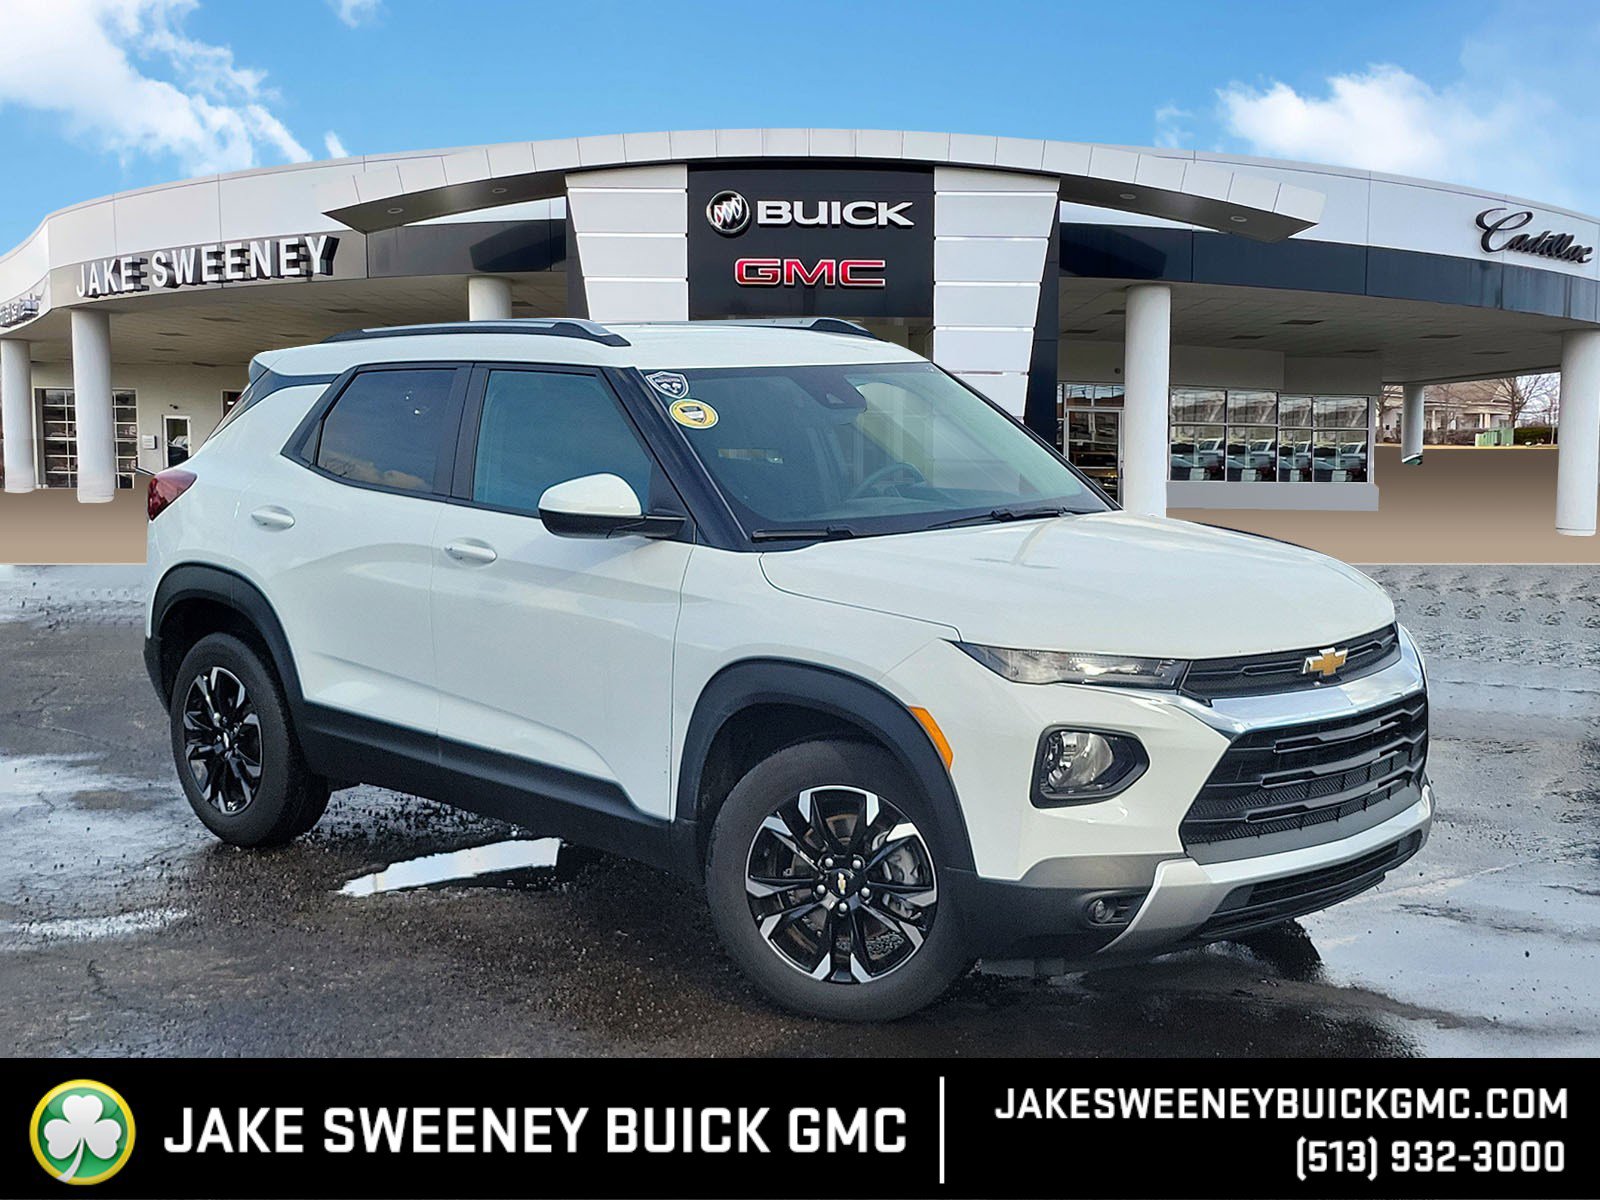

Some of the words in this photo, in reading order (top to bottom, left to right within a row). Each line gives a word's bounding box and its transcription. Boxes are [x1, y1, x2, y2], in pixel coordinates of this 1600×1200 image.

[757, 200, 915, 226] BUICK
[1475, 207, 1593, 264] Cadillac
[76, 257, 145, 297] JAKE
[151, 235, 337, 287] SWEENEY
[735, 258, 886, 287] GMC
